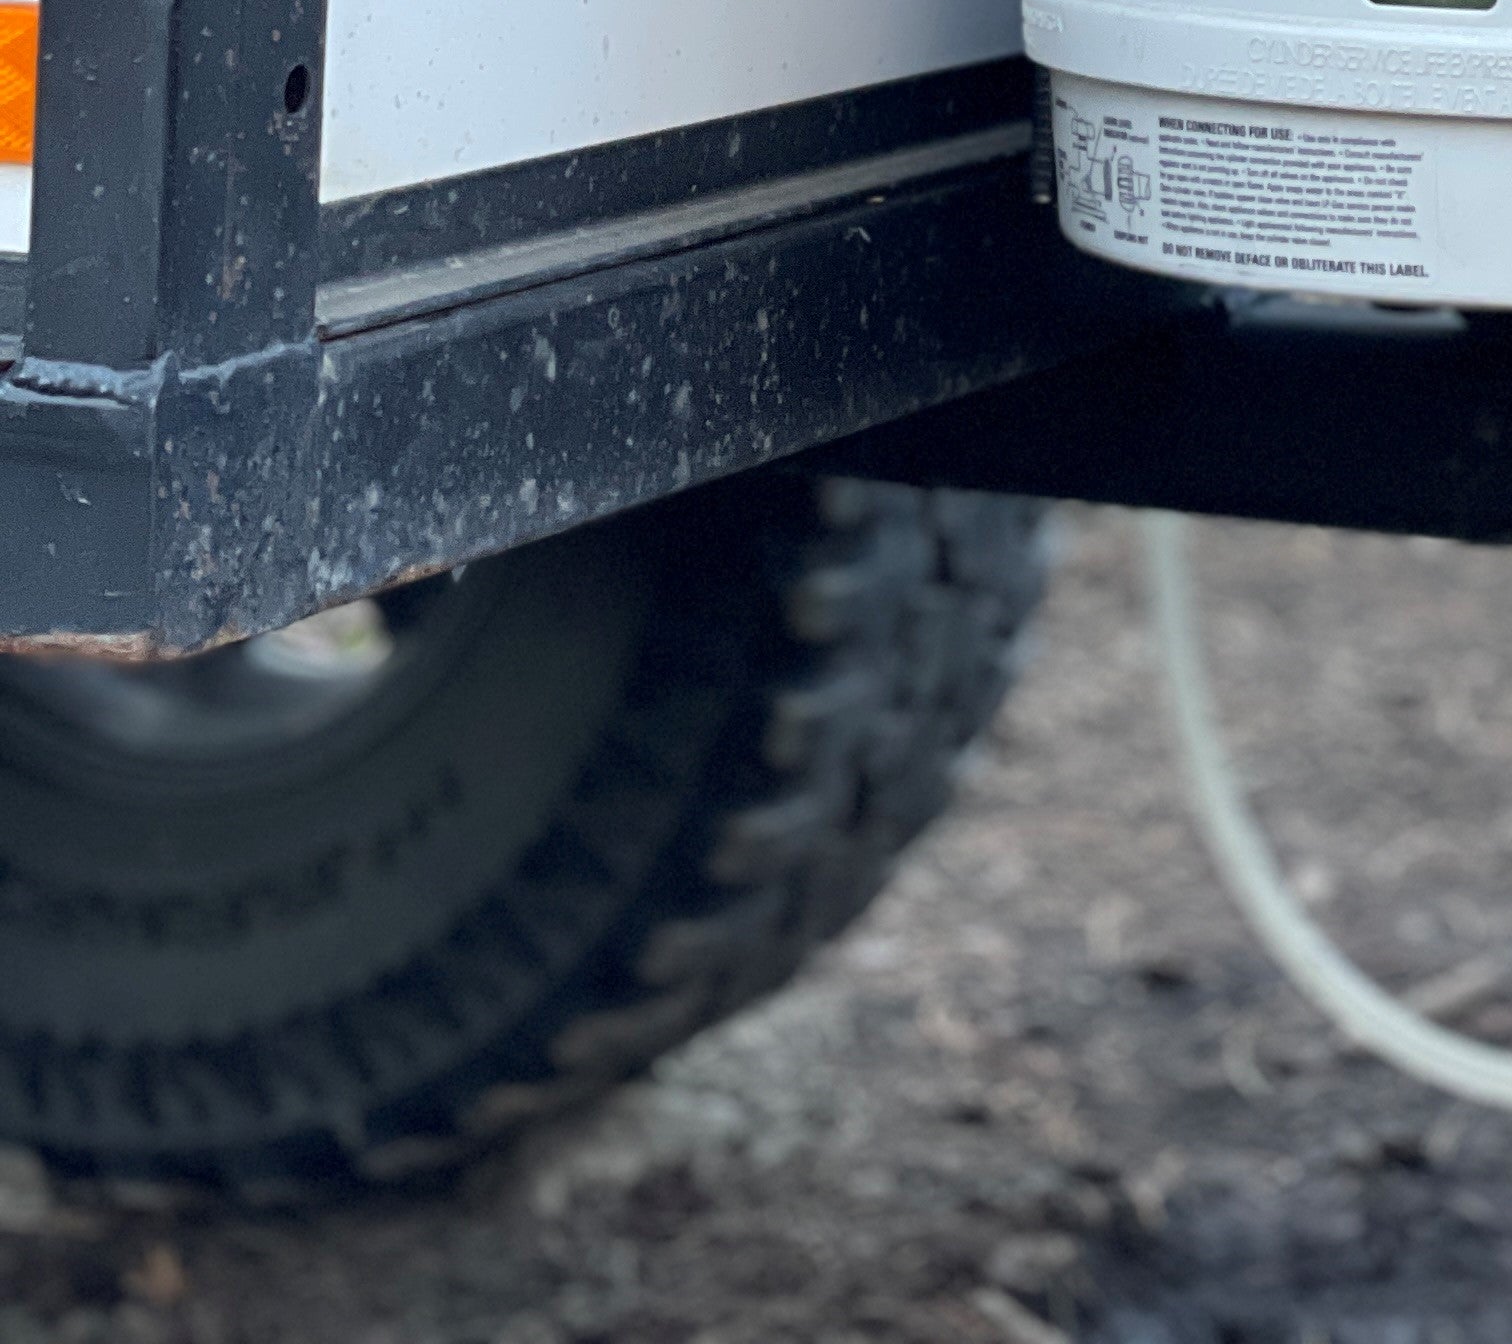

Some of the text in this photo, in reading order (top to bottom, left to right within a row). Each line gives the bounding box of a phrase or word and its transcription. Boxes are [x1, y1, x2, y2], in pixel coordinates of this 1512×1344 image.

[1158, 117, 1184, 130] WHEN
[1186, 120, 1247, 138] CONNECTING
[1249, 126, 1268, 139] FOR
[1162, 242, 1174, 255] DO
[1175, 243, 1193, 258] NOT
[1195, 246, 1232, 264] REMOVE
[1235, 252, 1272, 268] DEFACE
[1274, 256, 1289, 268] OR
[1291, 257, 1357, 274] OBLITERATE
[1359, 261, 1386, 276] THIS
